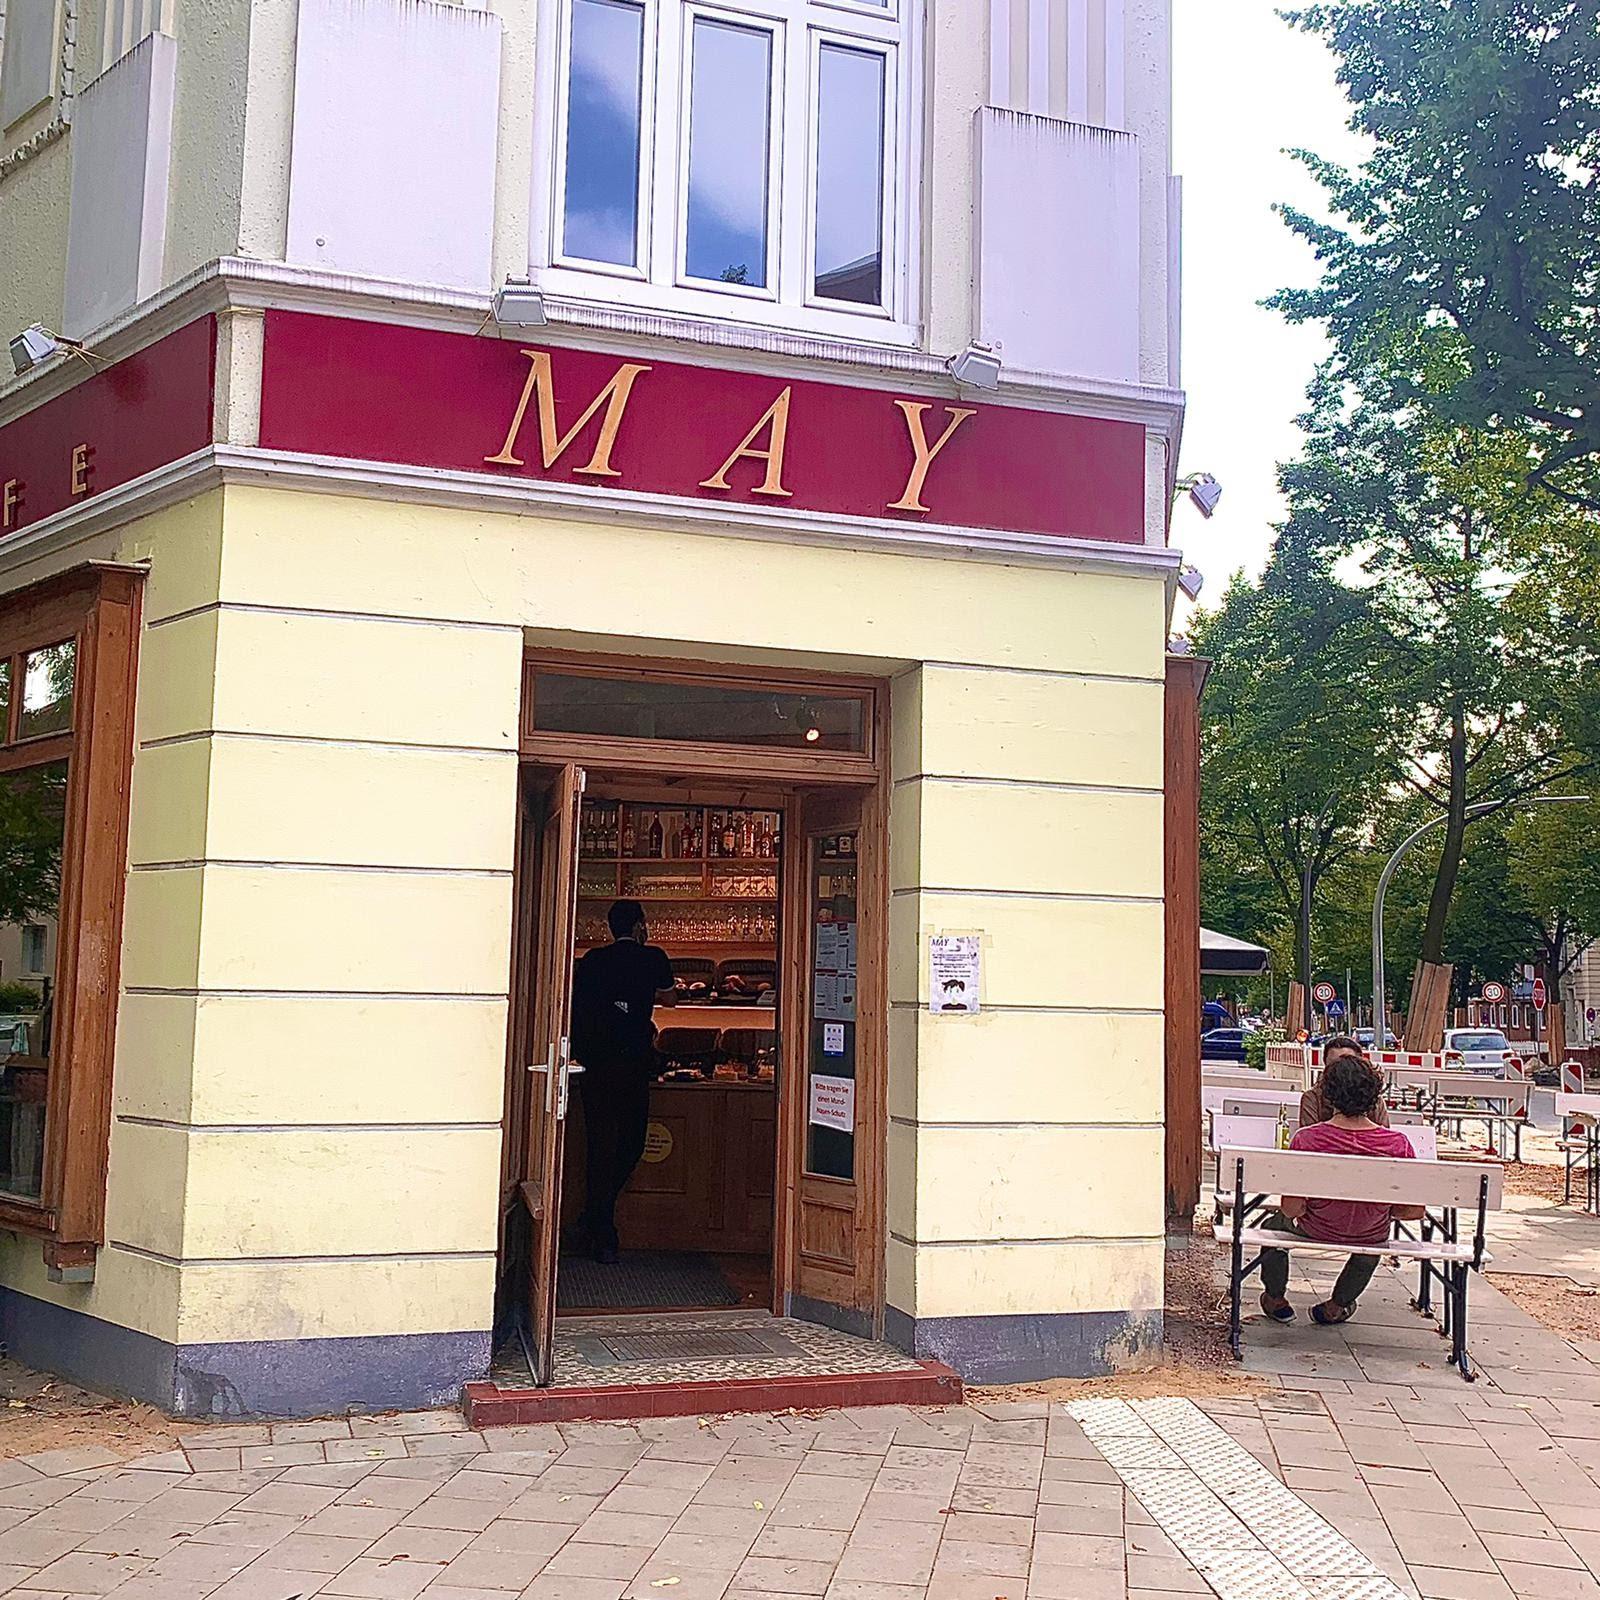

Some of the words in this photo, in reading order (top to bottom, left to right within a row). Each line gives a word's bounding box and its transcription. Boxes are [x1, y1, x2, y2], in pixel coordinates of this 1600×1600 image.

[484, 349, 977, 512] MAY
[931, 938, 949, 947] MAY
[1319, 988, 1330, 997] 30
[1487, 987, 1499, 997] 30
[815, 1083, 826, 1091] Bitte
[826, 1085, 842, 1093] tragen
